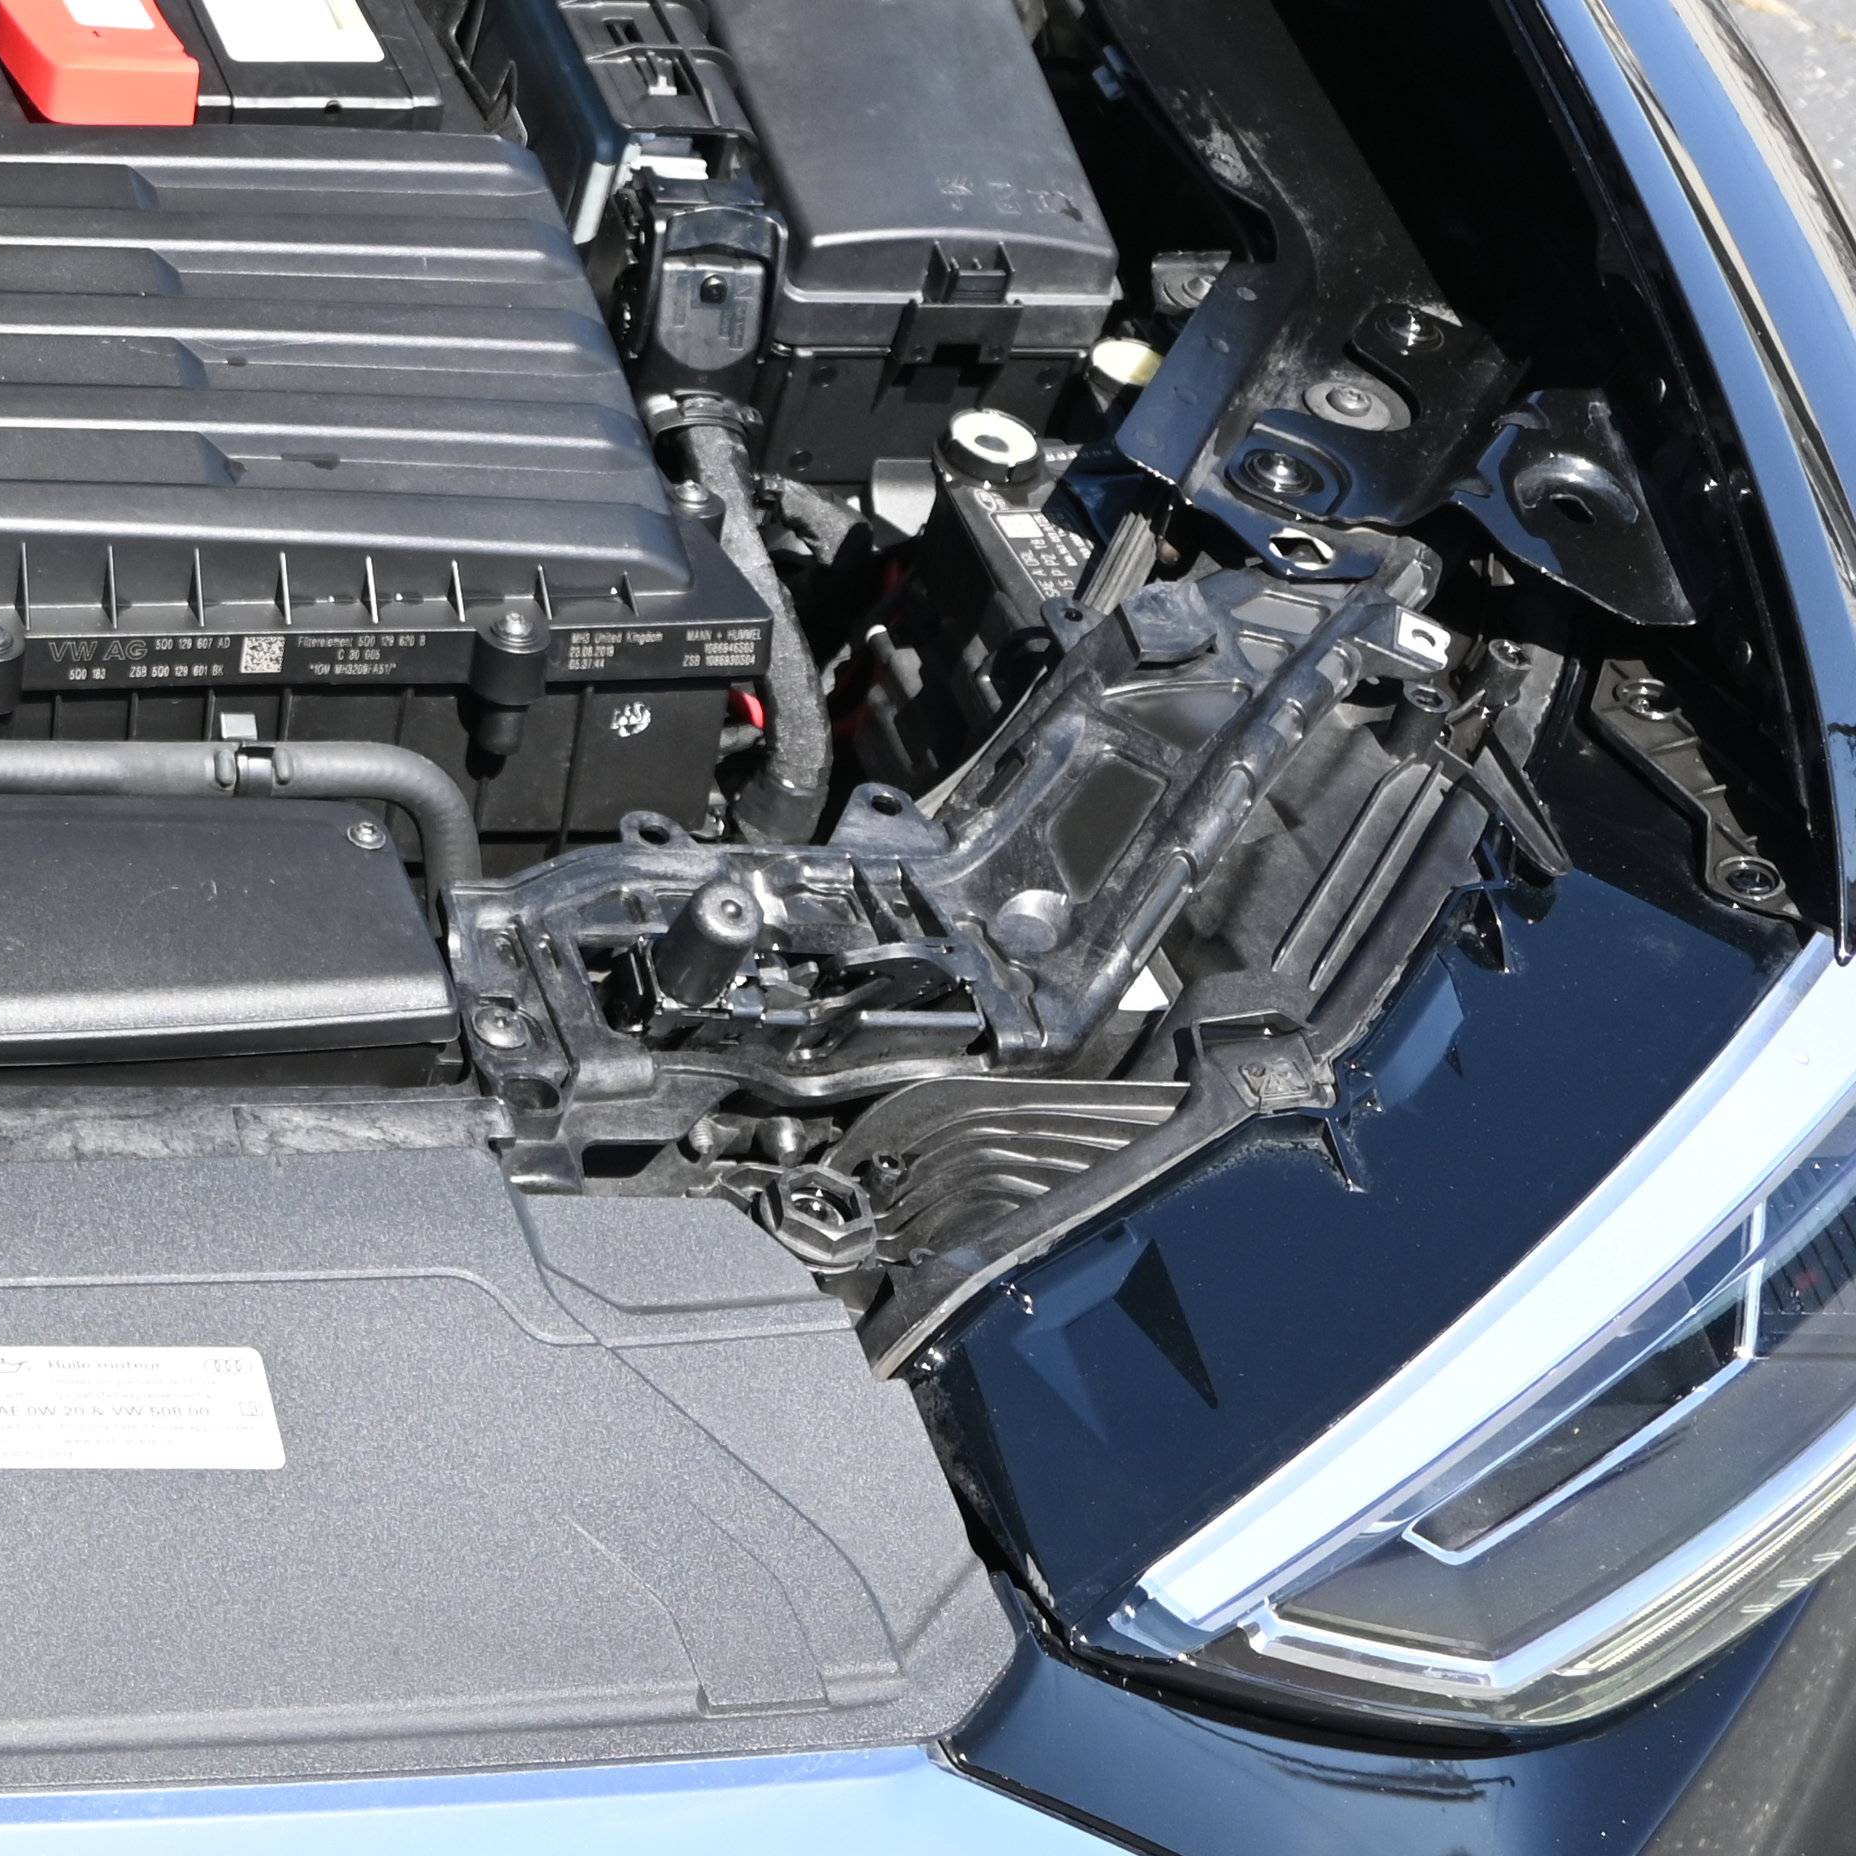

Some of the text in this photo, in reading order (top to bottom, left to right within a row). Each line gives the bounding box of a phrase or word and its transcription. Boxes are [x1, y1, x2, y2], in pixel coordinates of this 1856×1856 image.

[357, 635, 376, 647] 5Q0
[419, 634, 426, 647] B
[594, 632, 622, 643] United
[625, 631, 664, 645] Kingdom
[686, 629, 713, 642] MANN
[727, 628, 762, 641] HUMMEL
[154, 636, 231, 651] 5Q0 129 607 AD
[48, 639, 149, 663] VW AG
[337, 649, 345, 661] C
[349, 649, 360, 660] 30
[151, 665, 170, 678] 5Q0
[174, 665, 189, 677] 129
[192, 665, 209, 677] 601
[212, 664, 225, 676] BK
[48, 1359, 161, 1370] Huile moteur
[91, 1405, 105, 1417] &
[111, 1406, 143, 1417] VW
[188, 1406, 210, 1417] 00
